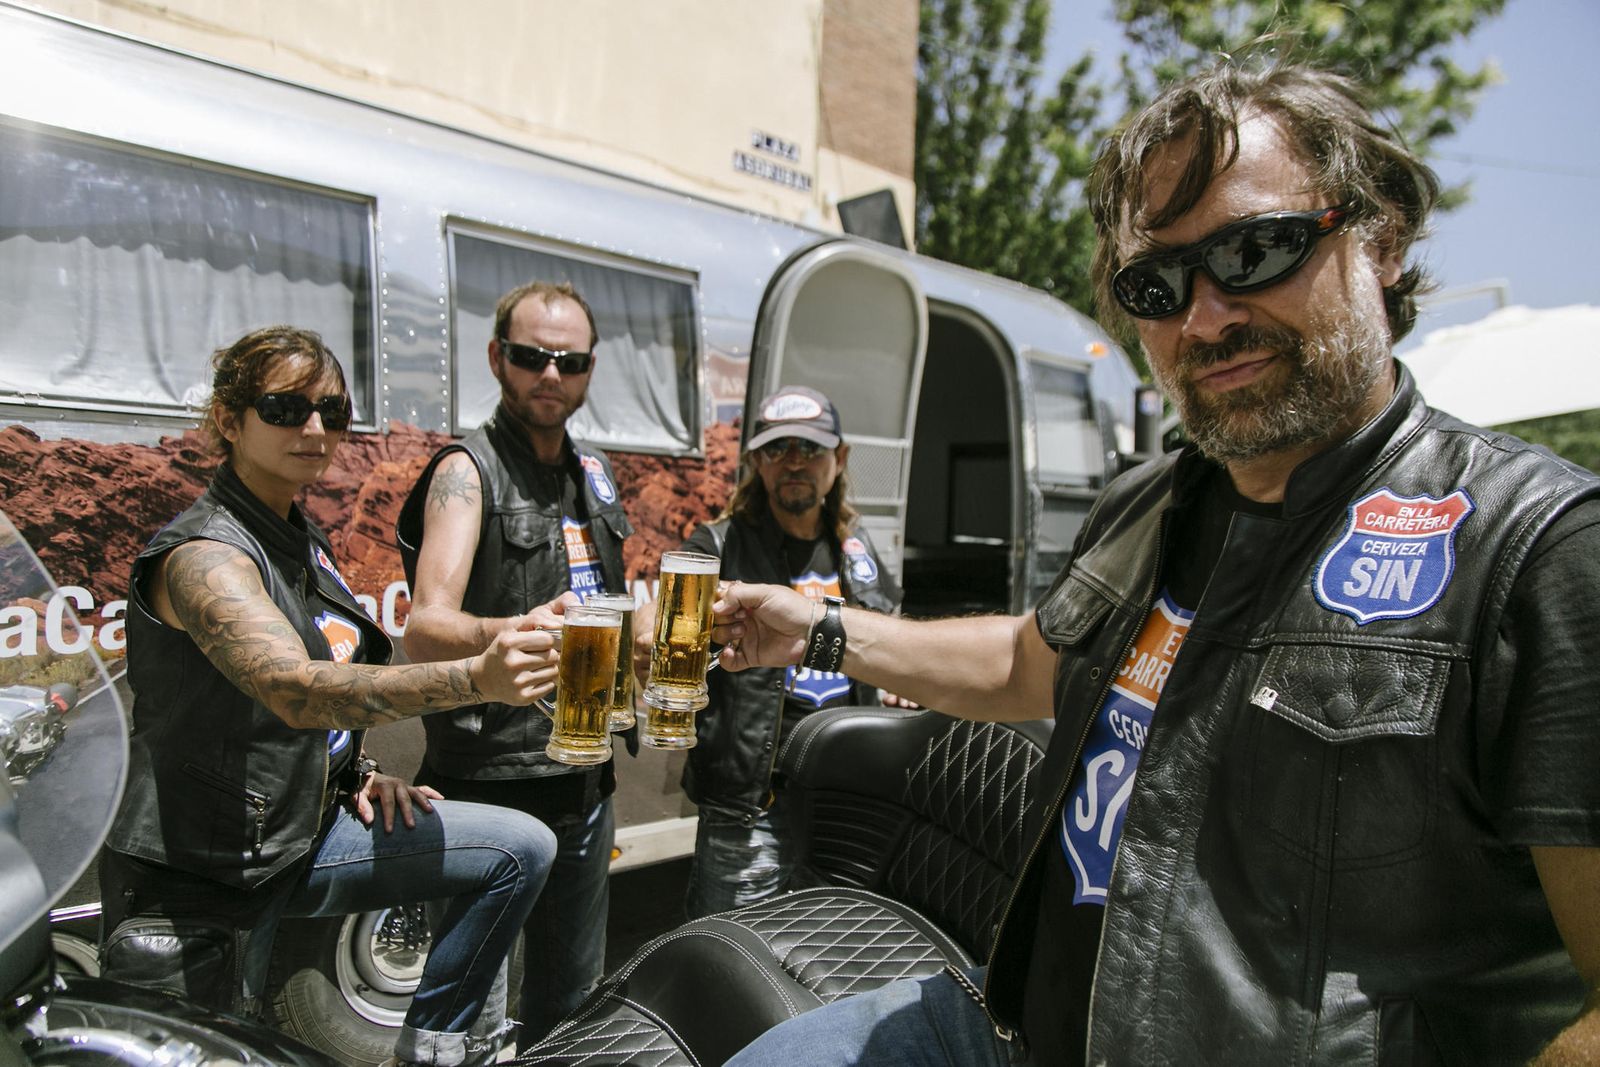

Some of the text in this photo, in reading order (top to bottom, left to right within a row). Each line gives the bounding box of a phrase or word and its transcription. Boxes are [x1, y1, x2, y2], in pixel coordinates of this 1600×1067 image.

[1364, 511, 1450, 532] CARRETERA
[1397, 506, 1433, 518] EN LA
[1361, 539, 1428, 556] CERVEZA
[1343, 556, 1423, 602] SIN
